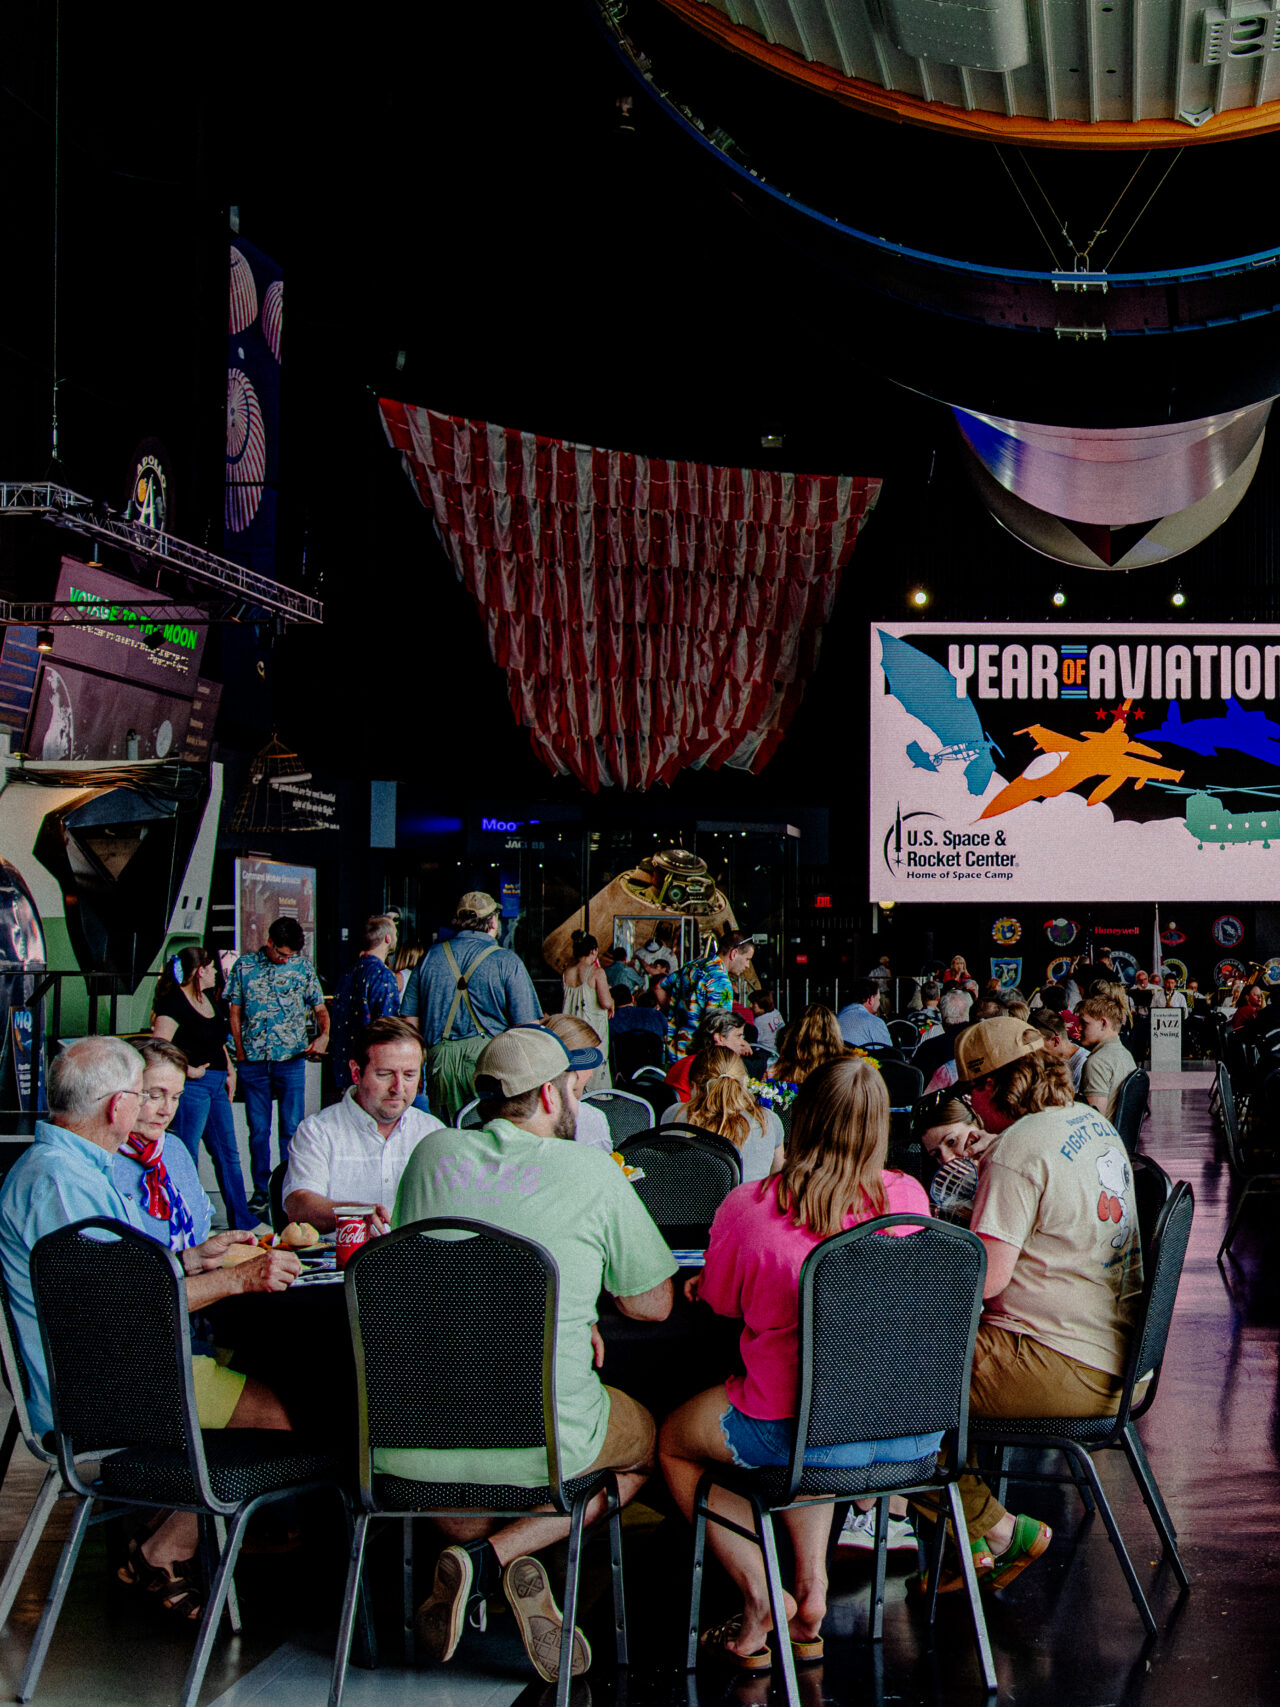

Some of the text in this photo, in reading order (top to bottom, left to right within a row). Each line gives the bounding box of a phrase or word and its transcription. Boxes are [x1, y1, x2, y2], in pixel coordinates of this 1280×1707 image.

[70, 586, 120, 621] VOYAGE
[122, 608, 137, 629] TO
[163, 623, 198, 650] MOON
[948, 644, 1059, 699] YEAR
[1062, 658, 1086, 685] OF
[481, 818, 524, 831] Moo
[907, 830, 1006, 850] U.S. Space &
[907, 850, 1016, 867] Rocket Center
[906, 871, 1013, 880] Home of Space Camp
[1094, 926, 1140, 936] Honeywell
[1060, 1121, 1118, 1162] FIGHT CLU
[433, 1156, 542, 1194] FACES
